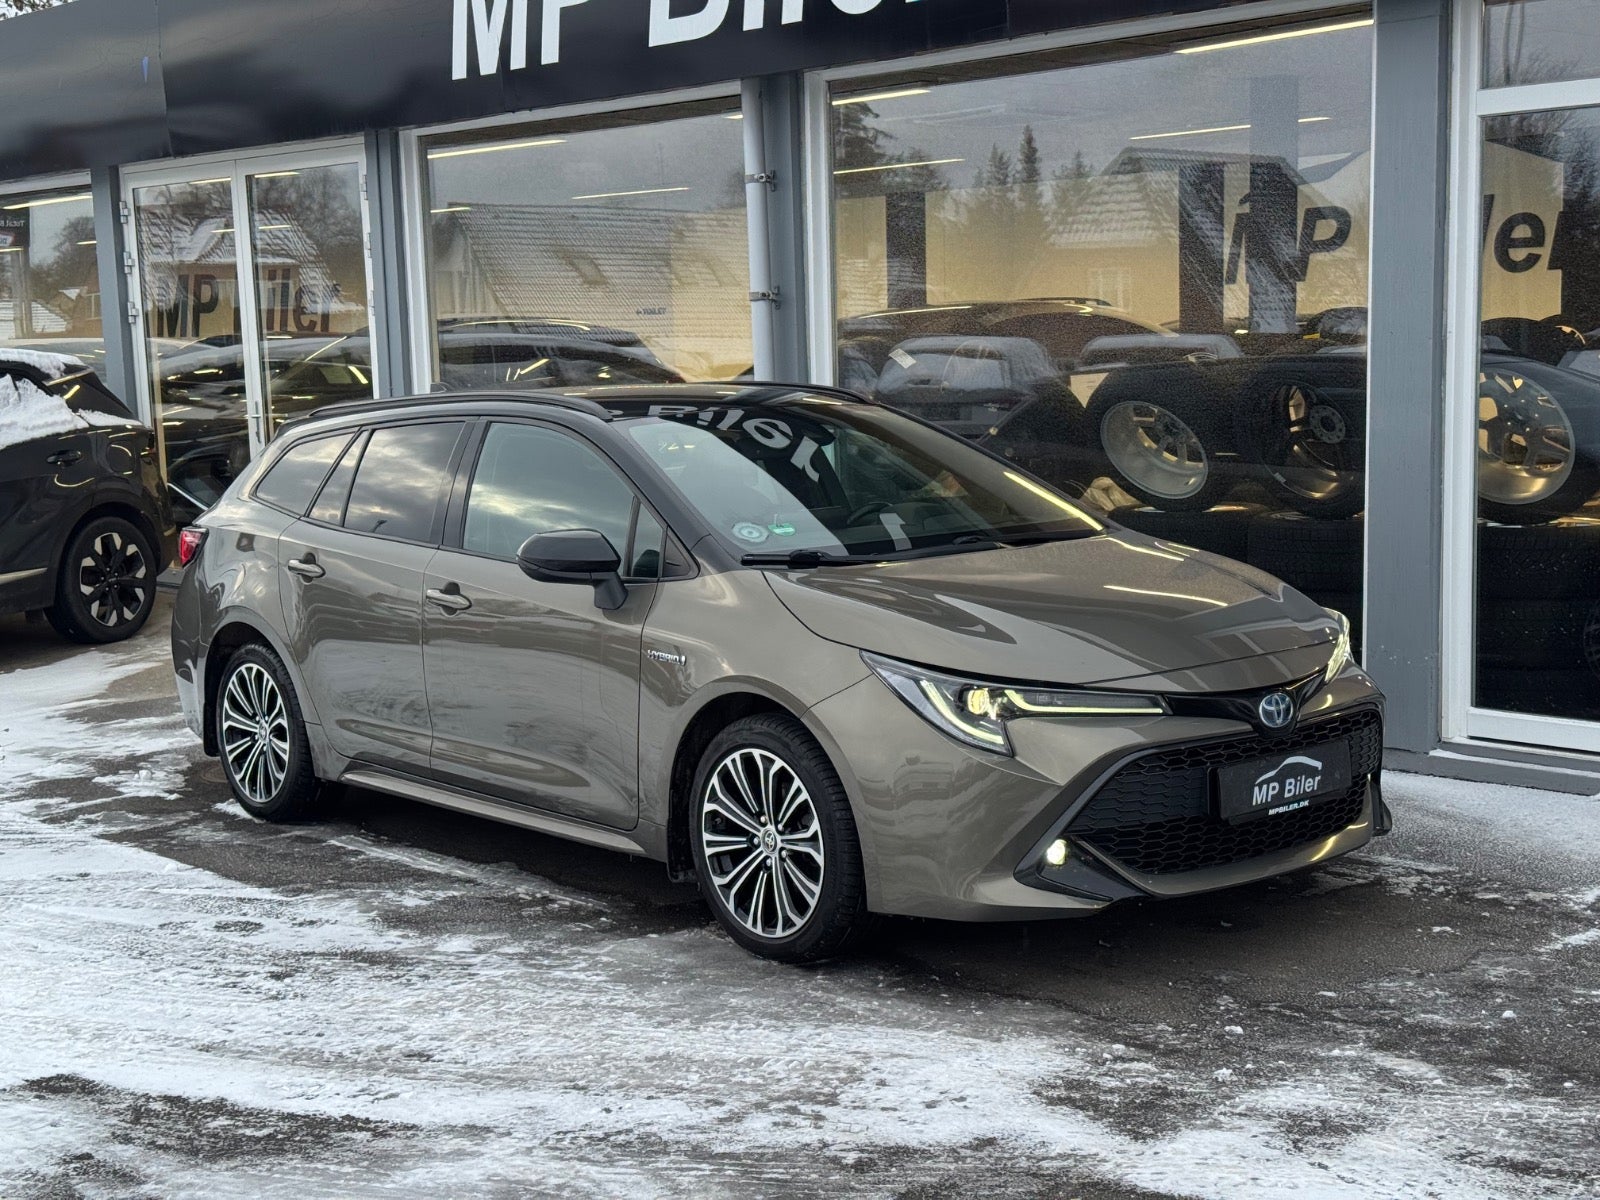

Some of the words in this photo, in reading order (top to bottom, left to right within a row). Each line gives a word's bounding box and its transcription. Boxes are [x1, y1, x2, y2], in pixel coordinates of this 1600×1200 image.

[647, 649, 680, 665] HYBRID
[1252, 781, 1279, 806] MP
[1284, 775, 1321, 798] Biler
[1268, 799, 1310, 815] MPBILER.DK
